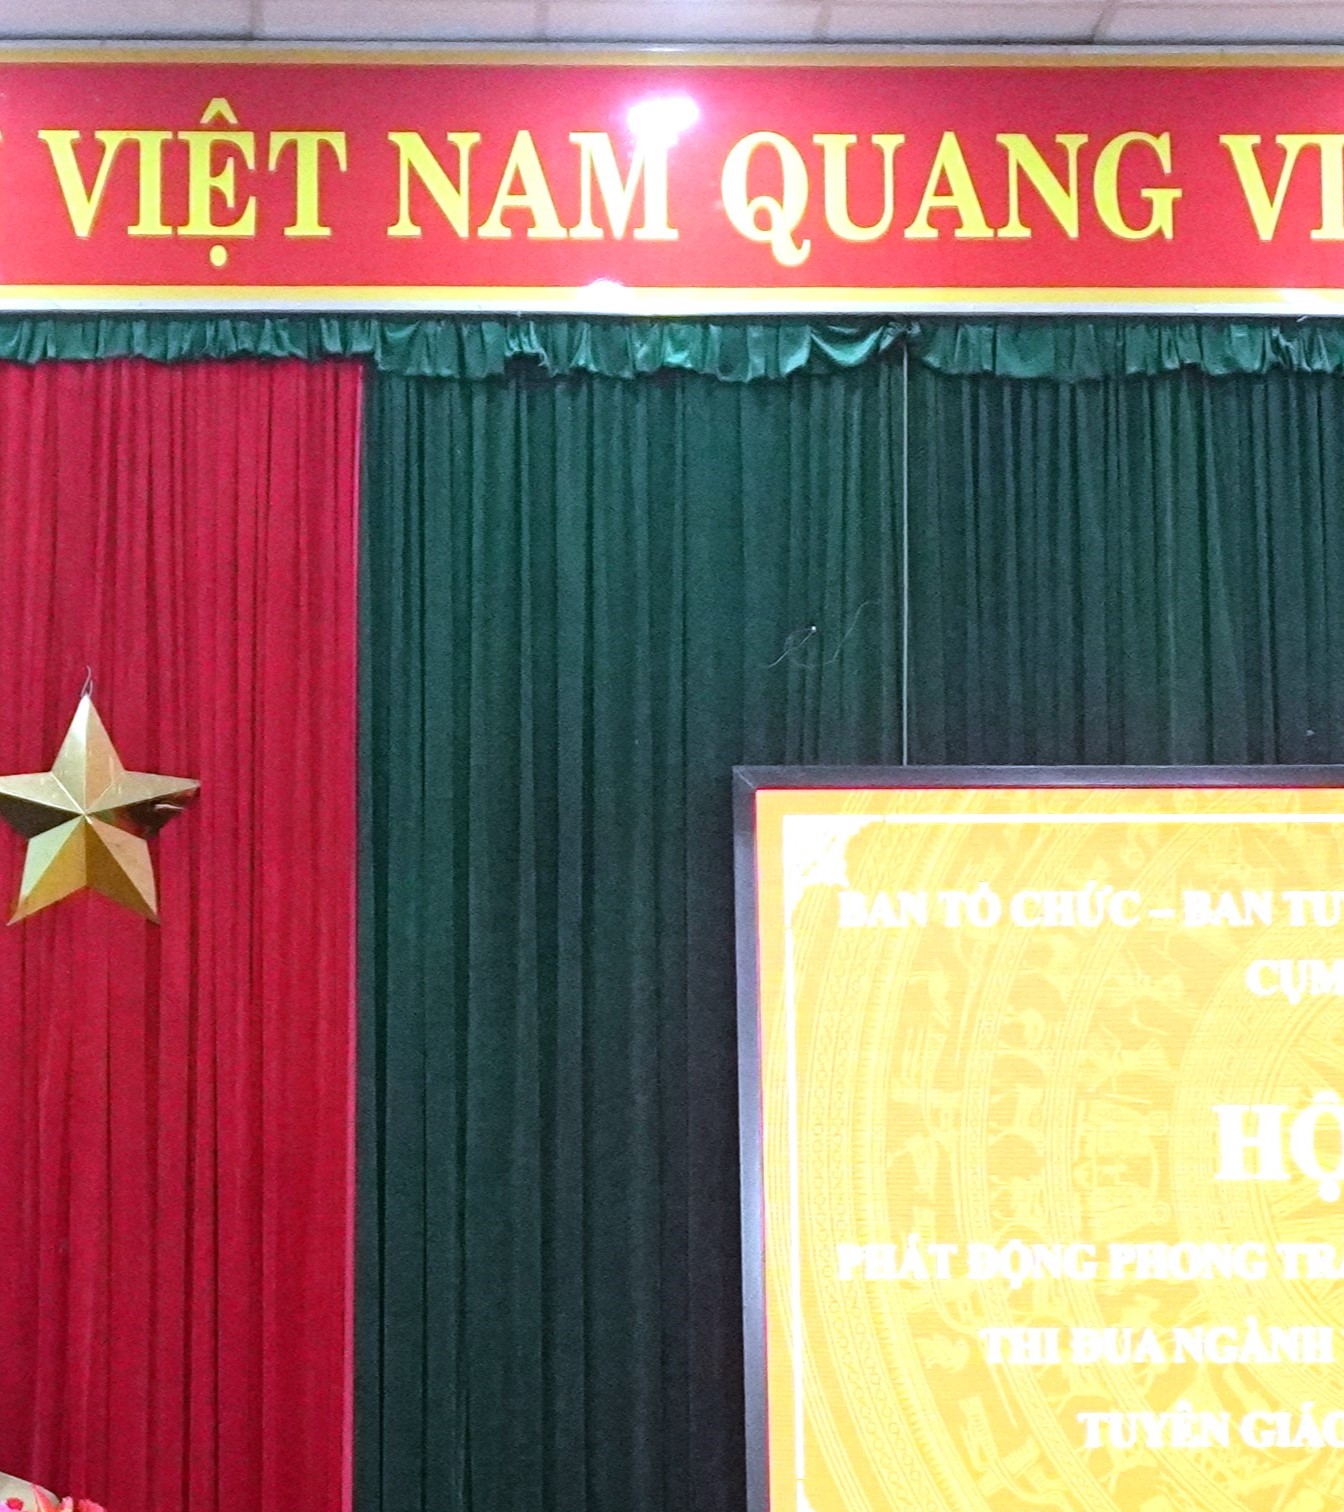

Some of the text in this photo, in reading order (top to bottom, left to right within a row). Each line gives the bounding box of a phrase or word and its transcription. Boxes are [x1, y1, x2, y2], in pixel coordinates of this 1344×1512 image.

[39, 97, 347, 267] VIỆT
[387, 131, 679, 241] NAM
[720, 131, 1182, 267] QUANG
[838, 889, 928, 928] BAN
[937, 882, 1001, 927] TỔ
[1010, 880, 1141, 927] CHỨC
[1183, 889, 1272, 928] BAN
[836, 1233, 958, 1281] PHÁT
[967, 1238, 1098, 1289] ĐỘNG
[1109, 1241, 1268, 1281] PHONG
[978, 1326, 1061, 1365] THI
[1071, 1326, 1166, 1365] ĐUA
[1173, 1317, 1335, 1365] NGÀNH
[1077, 1400, 1230, 1449] TUYÊN
